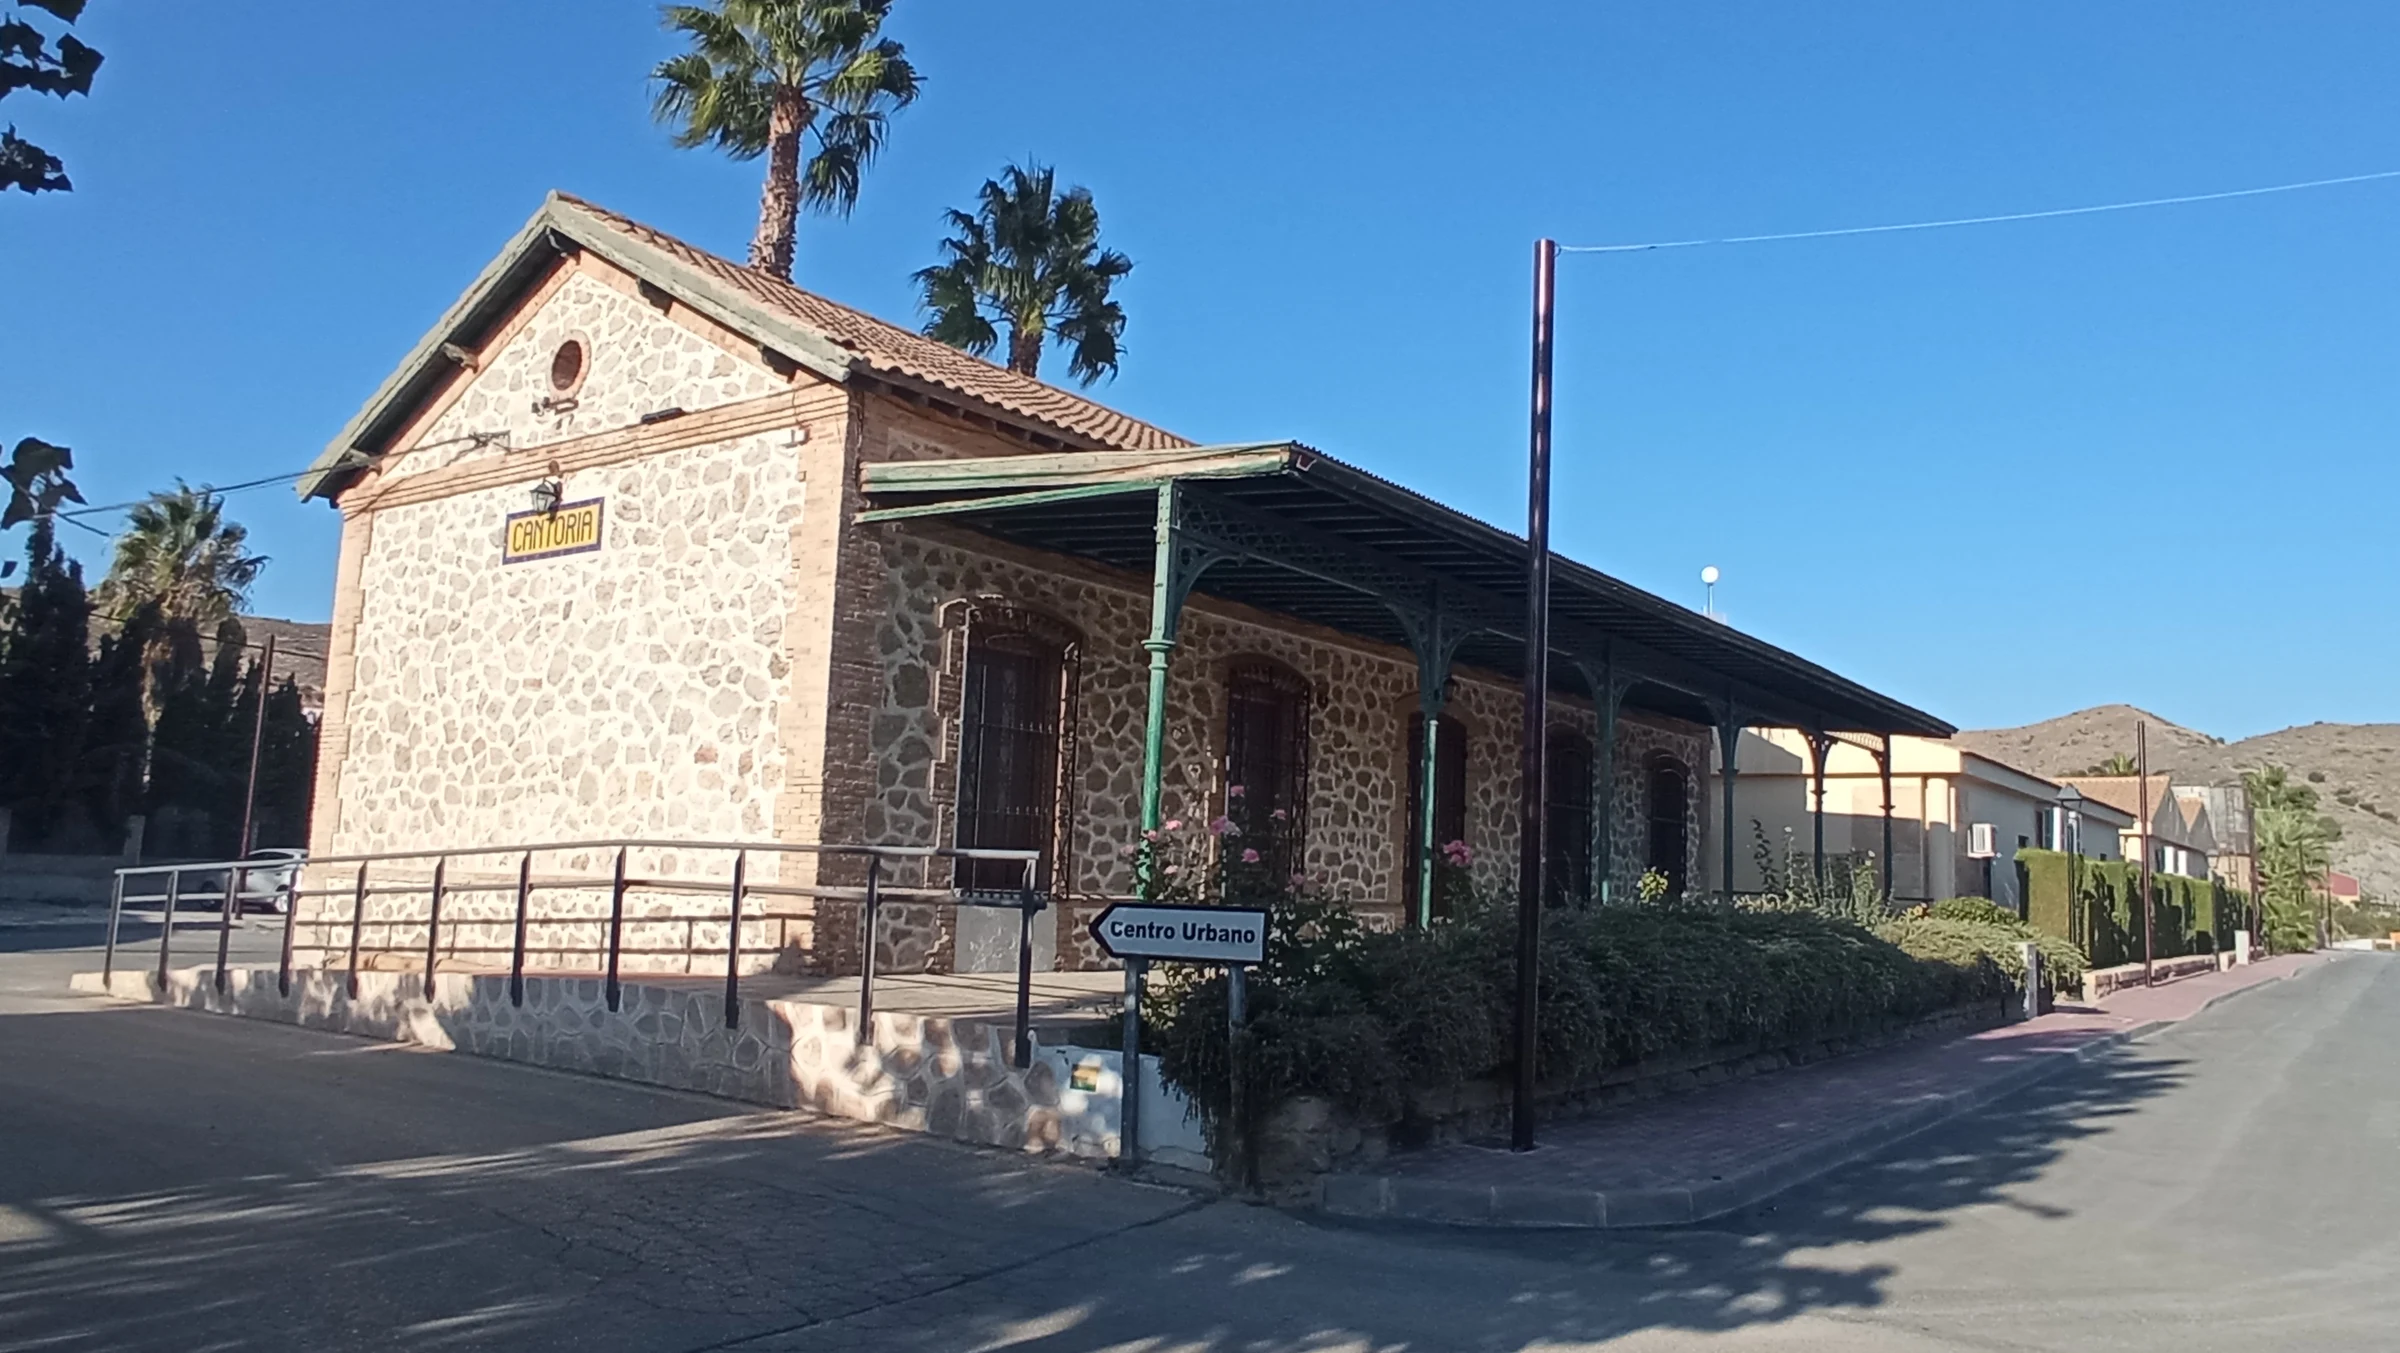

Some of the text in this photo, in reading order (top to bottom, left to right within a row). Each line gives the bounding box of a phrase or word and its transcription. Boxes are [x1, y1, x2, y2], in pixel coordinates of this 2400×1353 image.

[512, 510, 593, 553] CANTORIA
[1110, 921, 1255, 943] Centro Urbano
